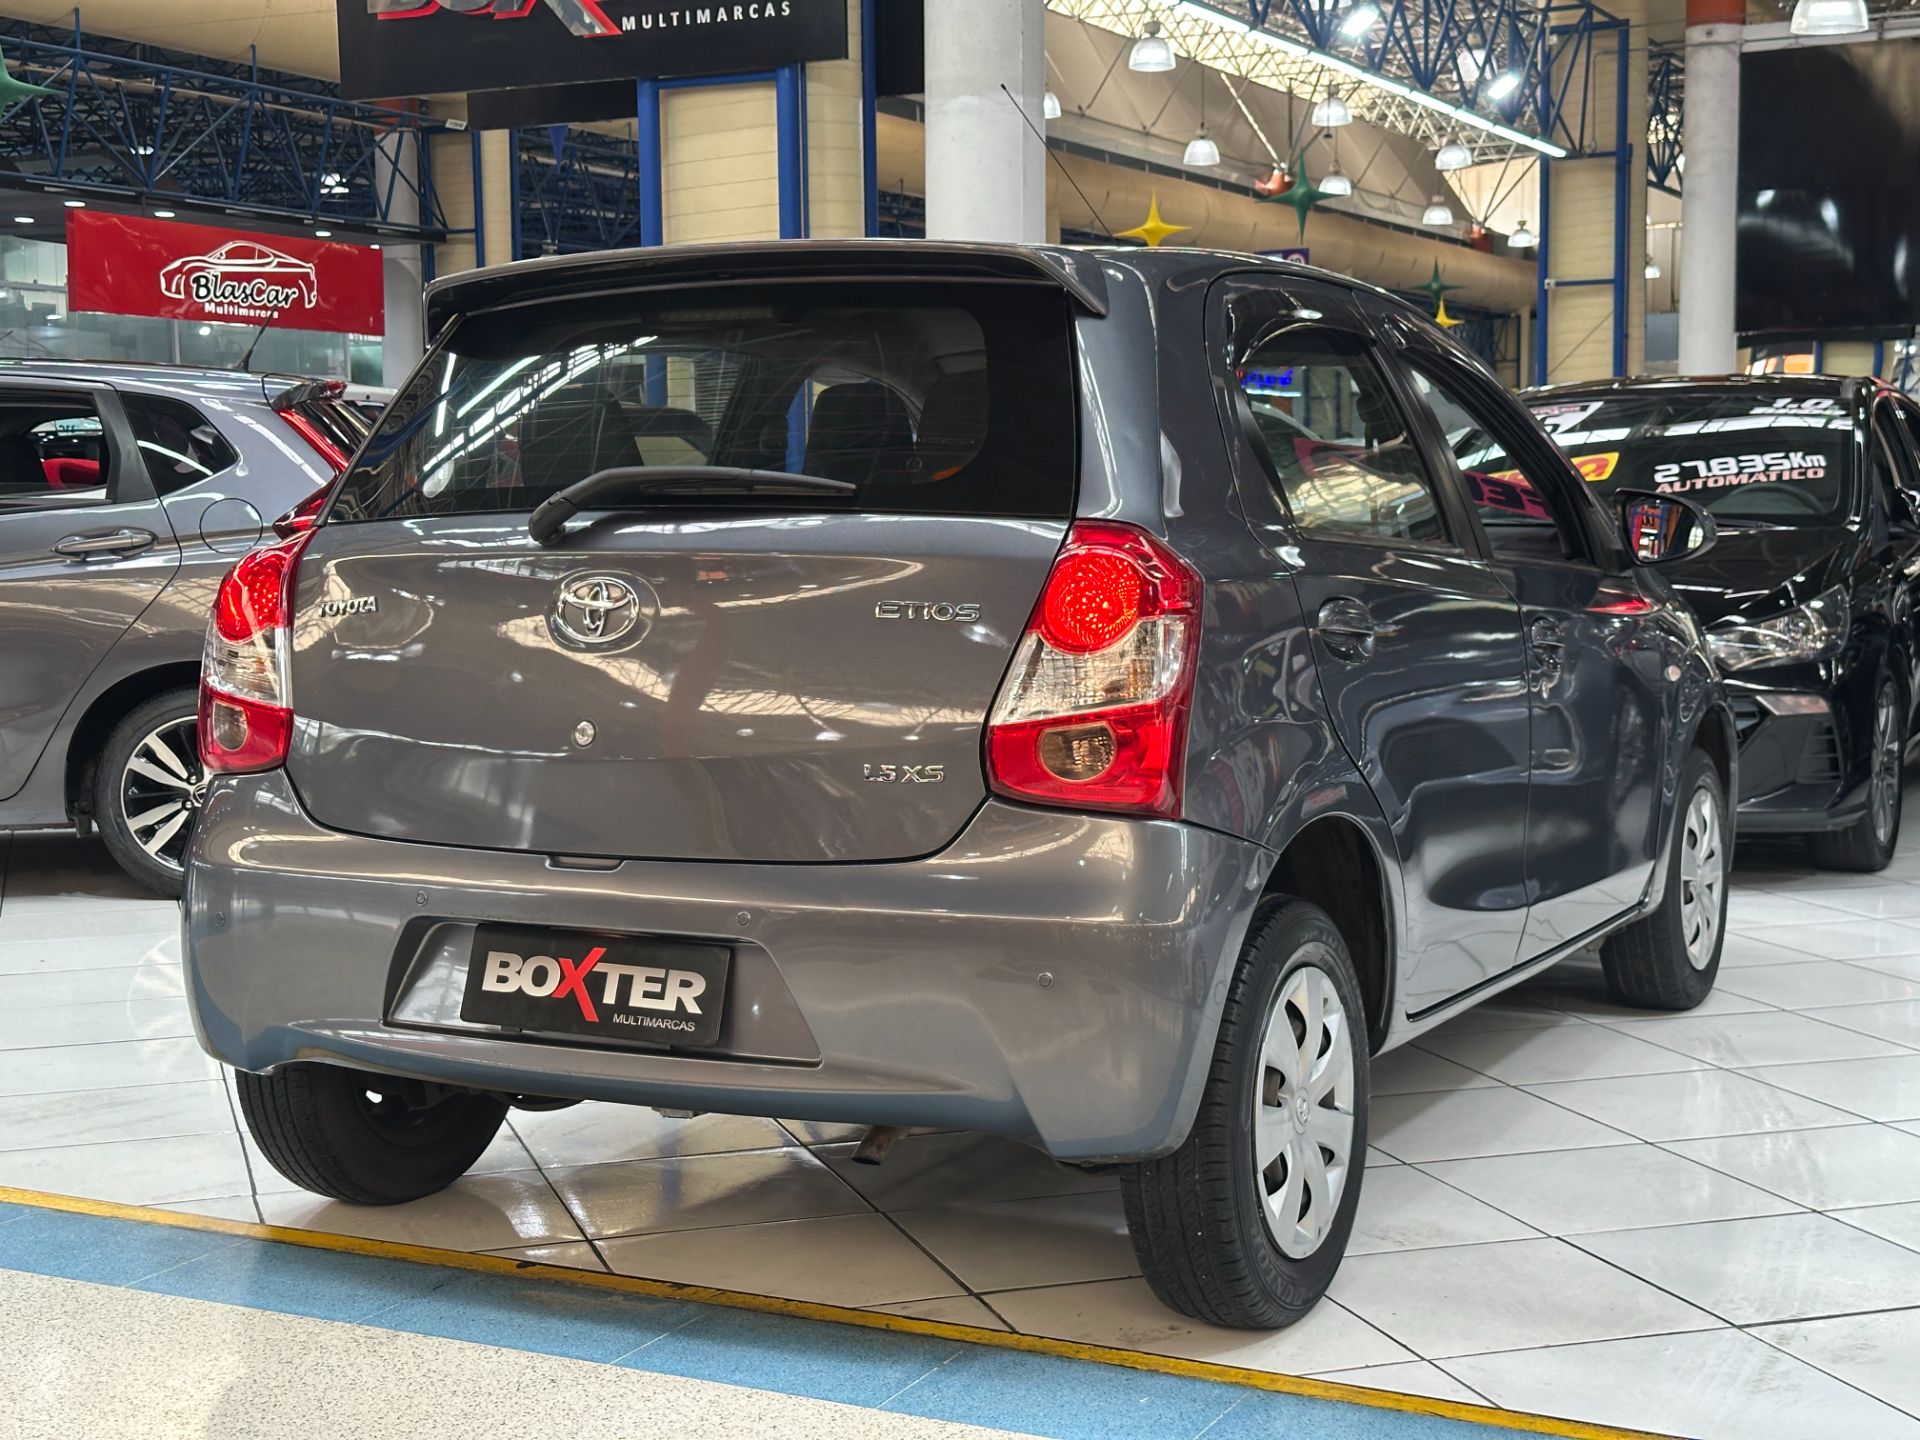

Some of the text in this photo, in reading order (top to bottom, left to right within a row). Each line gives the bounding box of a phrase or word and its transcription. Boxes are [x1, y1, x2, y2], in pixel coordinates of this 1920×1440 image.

[621, 1, 791, 31] MULTIMARCAS
[190, 271, 299, 308] BlasCar
[1655, 467, 1825, 494] AUTOMATICO
[318, 596, 378, 617] TOYOTA
[875, 600, 980, 621] ETIOS
[900, 765, 945, 783] XS
[482, 947, 707, 1023] BOXTER
[612, 1013, 696, 1032] MULTIMARCAS
